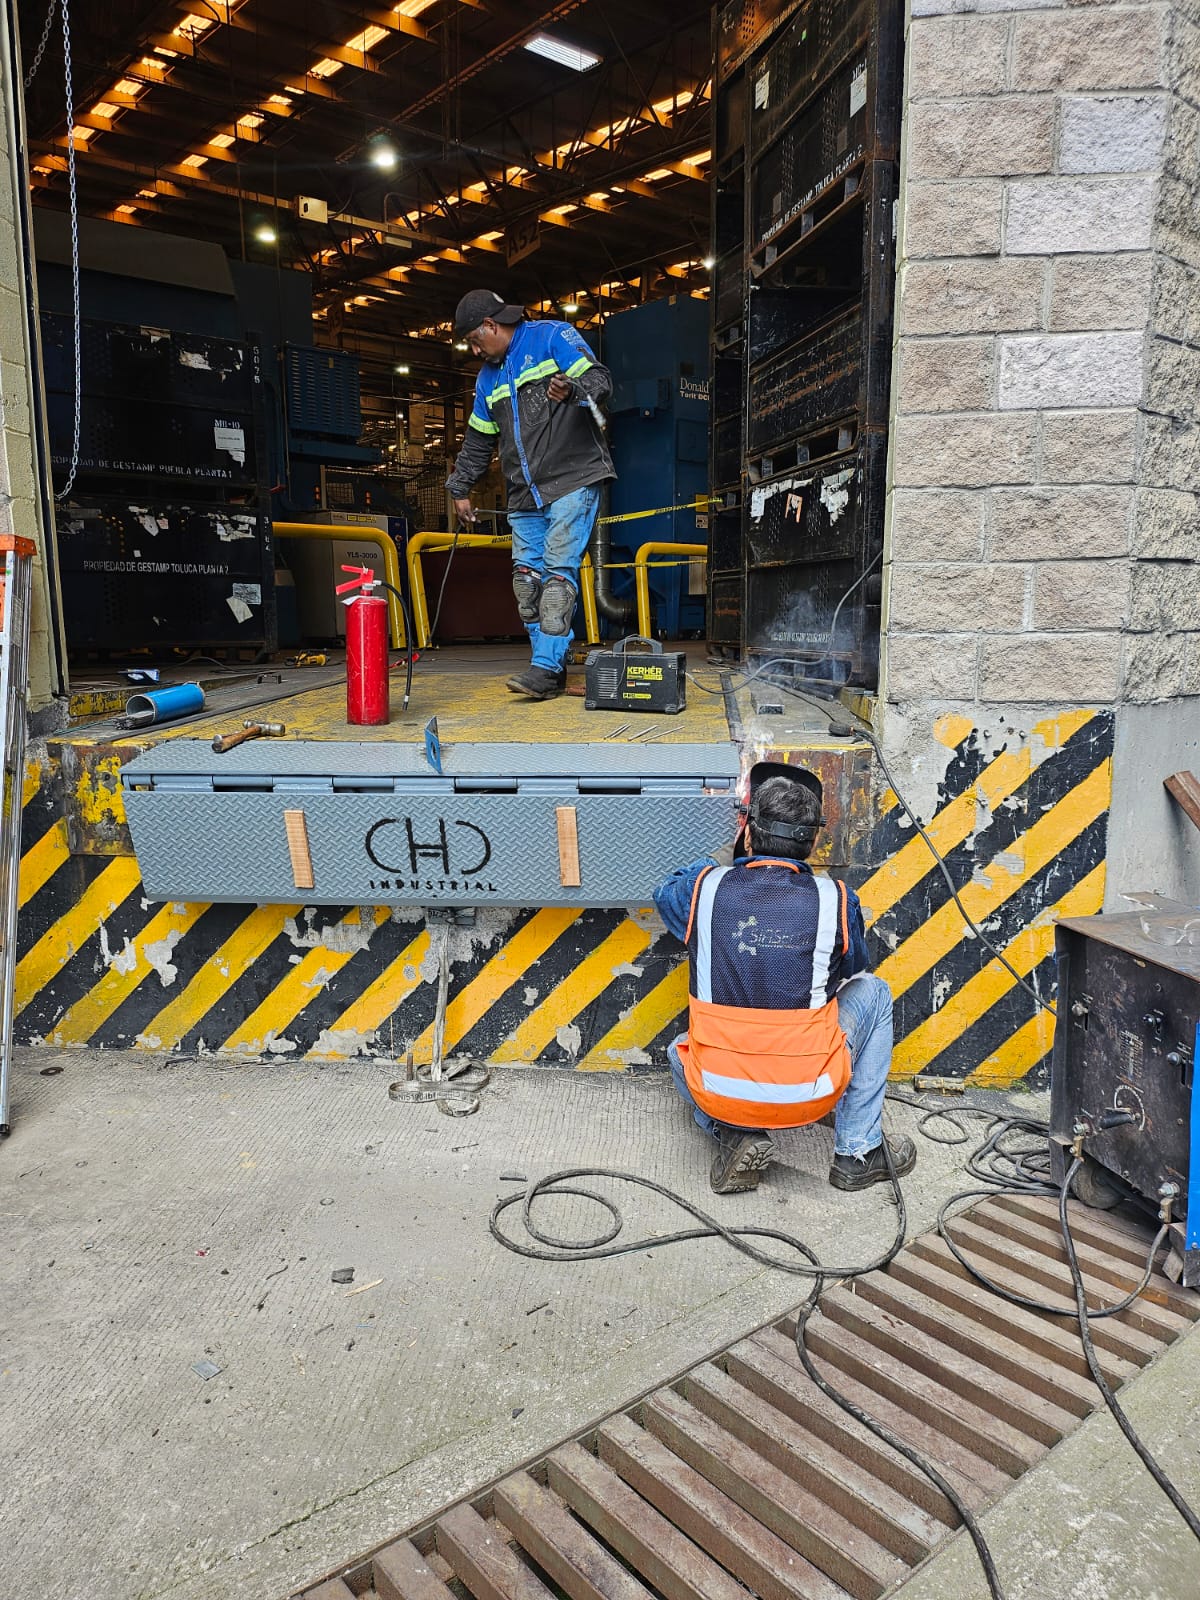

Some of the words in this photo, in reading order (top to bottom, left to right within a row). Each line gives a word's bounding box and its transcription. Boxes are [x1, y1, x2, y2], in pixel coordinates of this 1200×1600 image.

[791, 189, 813, 216] GESTAMP
[815, 171, 834, 196] TOLUCA
[836, 150, 855, 178] PLANTA
[98, 458, 111, 469] DE
[113, 459, 156, 473] GESTAMP
[158, 464, 193, 476] PUEBLA
[195, 467, 228, 479] PLANTA
[83, 560, 126, 572] PROPIEDAD
[126, 561, 137, 572] DE
[137, 561, 171, 573] GESTAMP
[171, 563, 198, 574] TOLUCA
[198, 564, 224, 575] PLANTA
[369, 879, 498, 892] INDUSTRIAL
